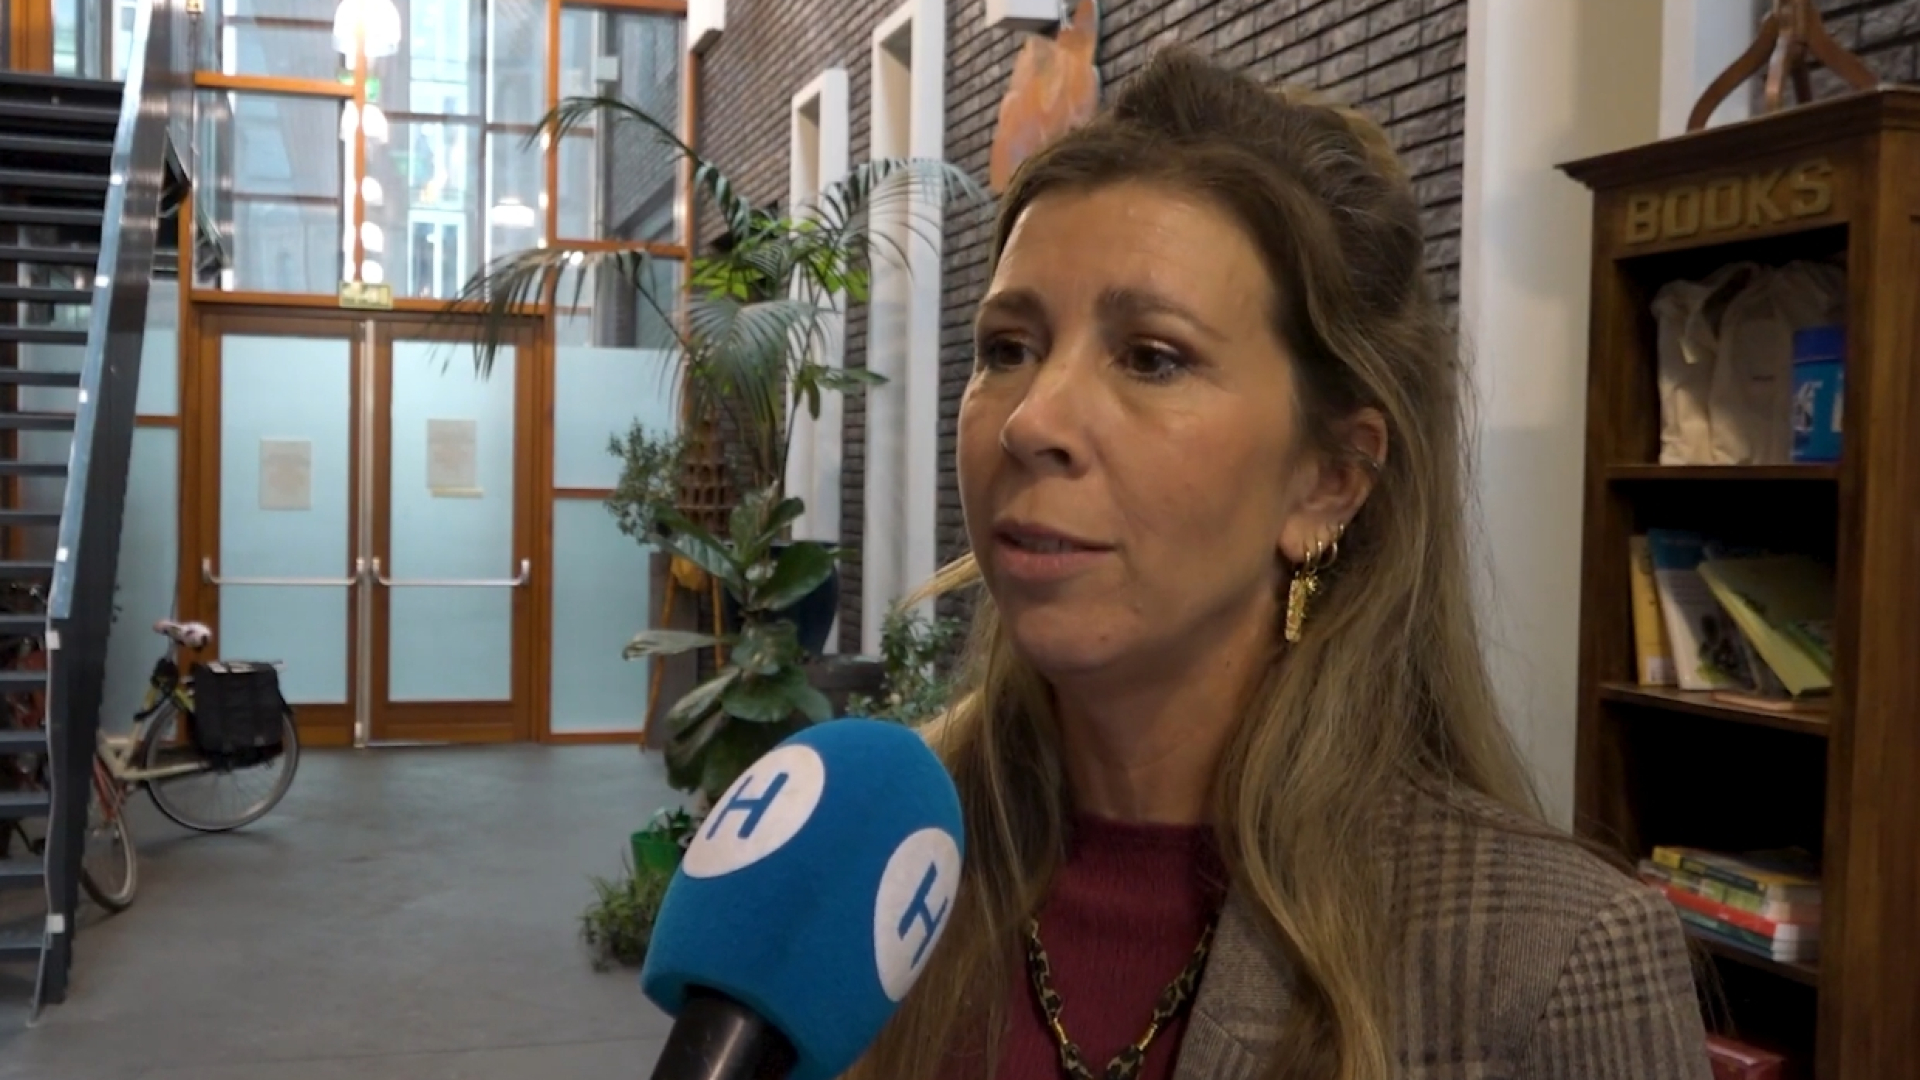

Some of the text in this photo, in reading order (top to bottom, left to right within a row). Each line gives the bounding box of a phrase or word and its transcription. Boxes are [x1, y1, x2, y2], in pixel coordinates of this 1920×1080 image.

[1625, 157, 1832, 244] BOOKS
[706, 772, 788, 840] H
[897, 862, 948, 970] H
